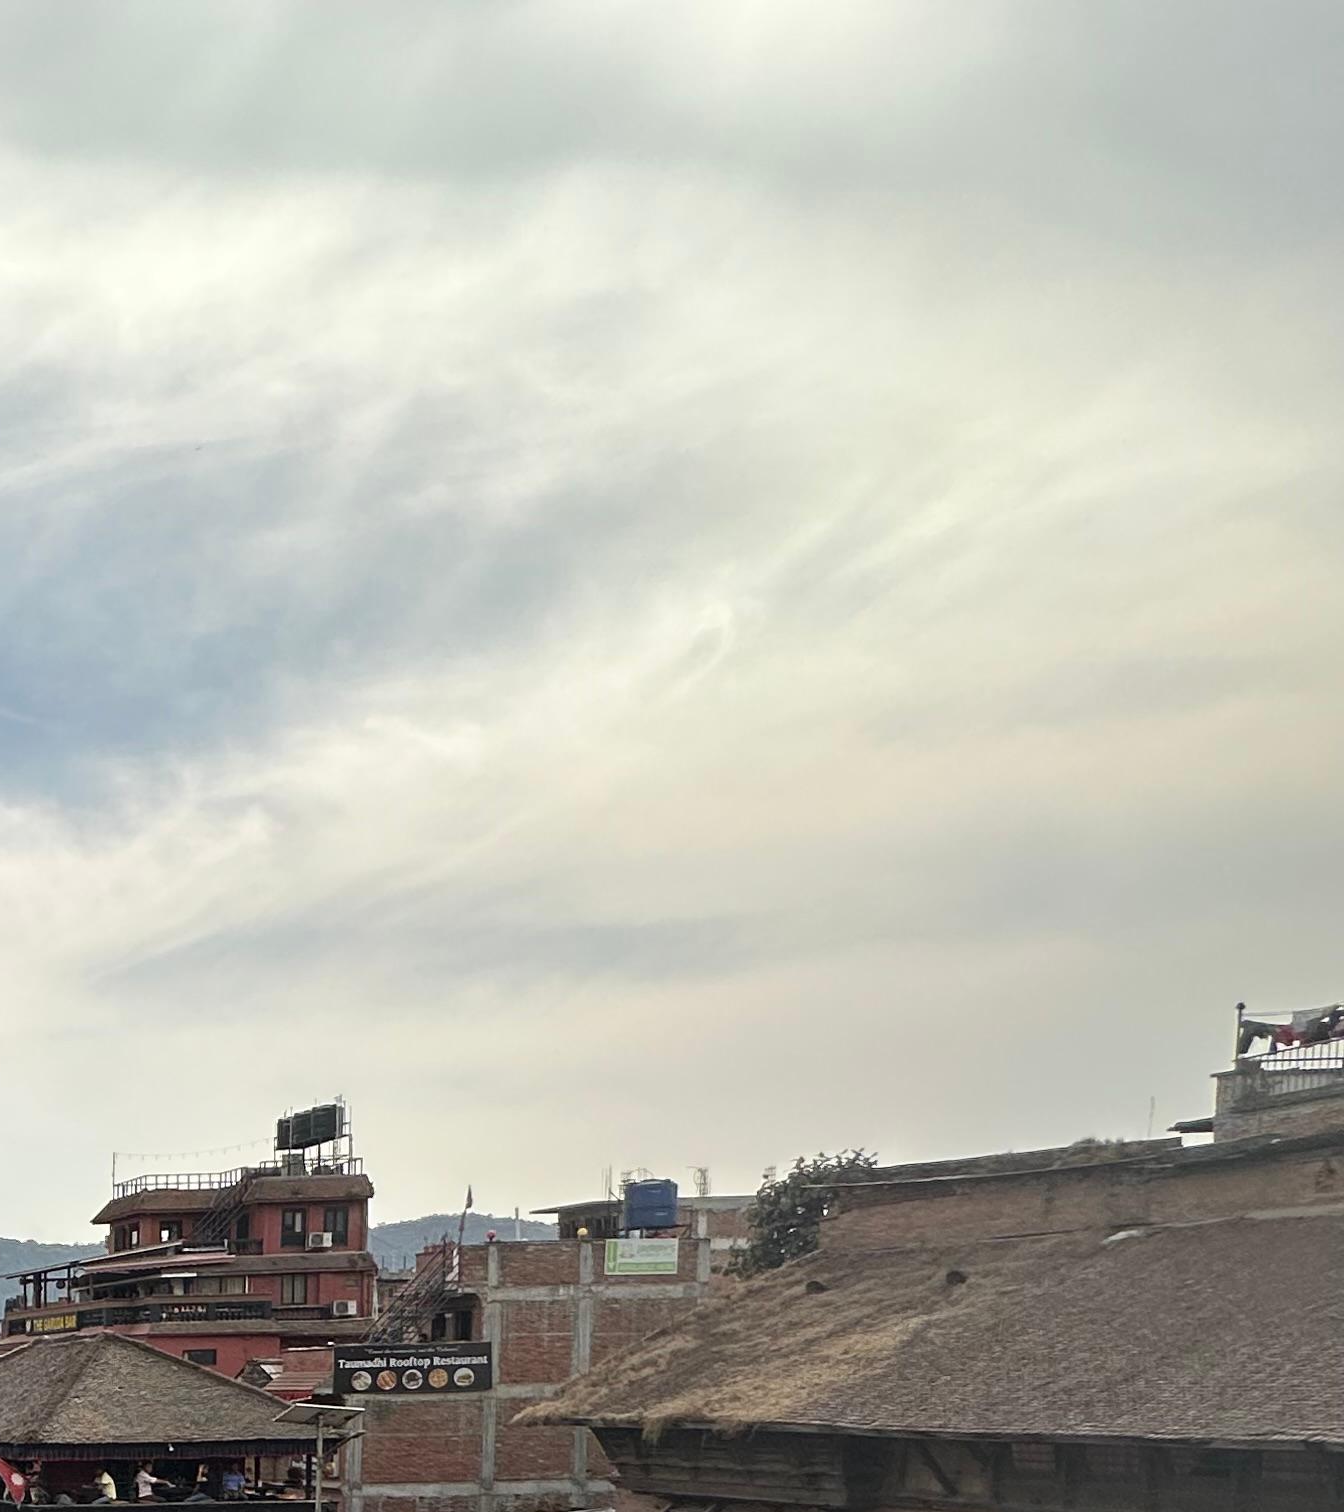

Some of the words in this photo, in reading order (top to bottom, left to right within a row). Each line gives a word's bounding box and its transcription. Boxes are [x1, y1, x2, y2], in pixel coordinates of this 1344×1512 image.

[338, 1357, 387, 1368] Taumadhi
[389, 1356, 431, 1369] Rooftop
[433, 1355, 489, 1366] Restaurant
